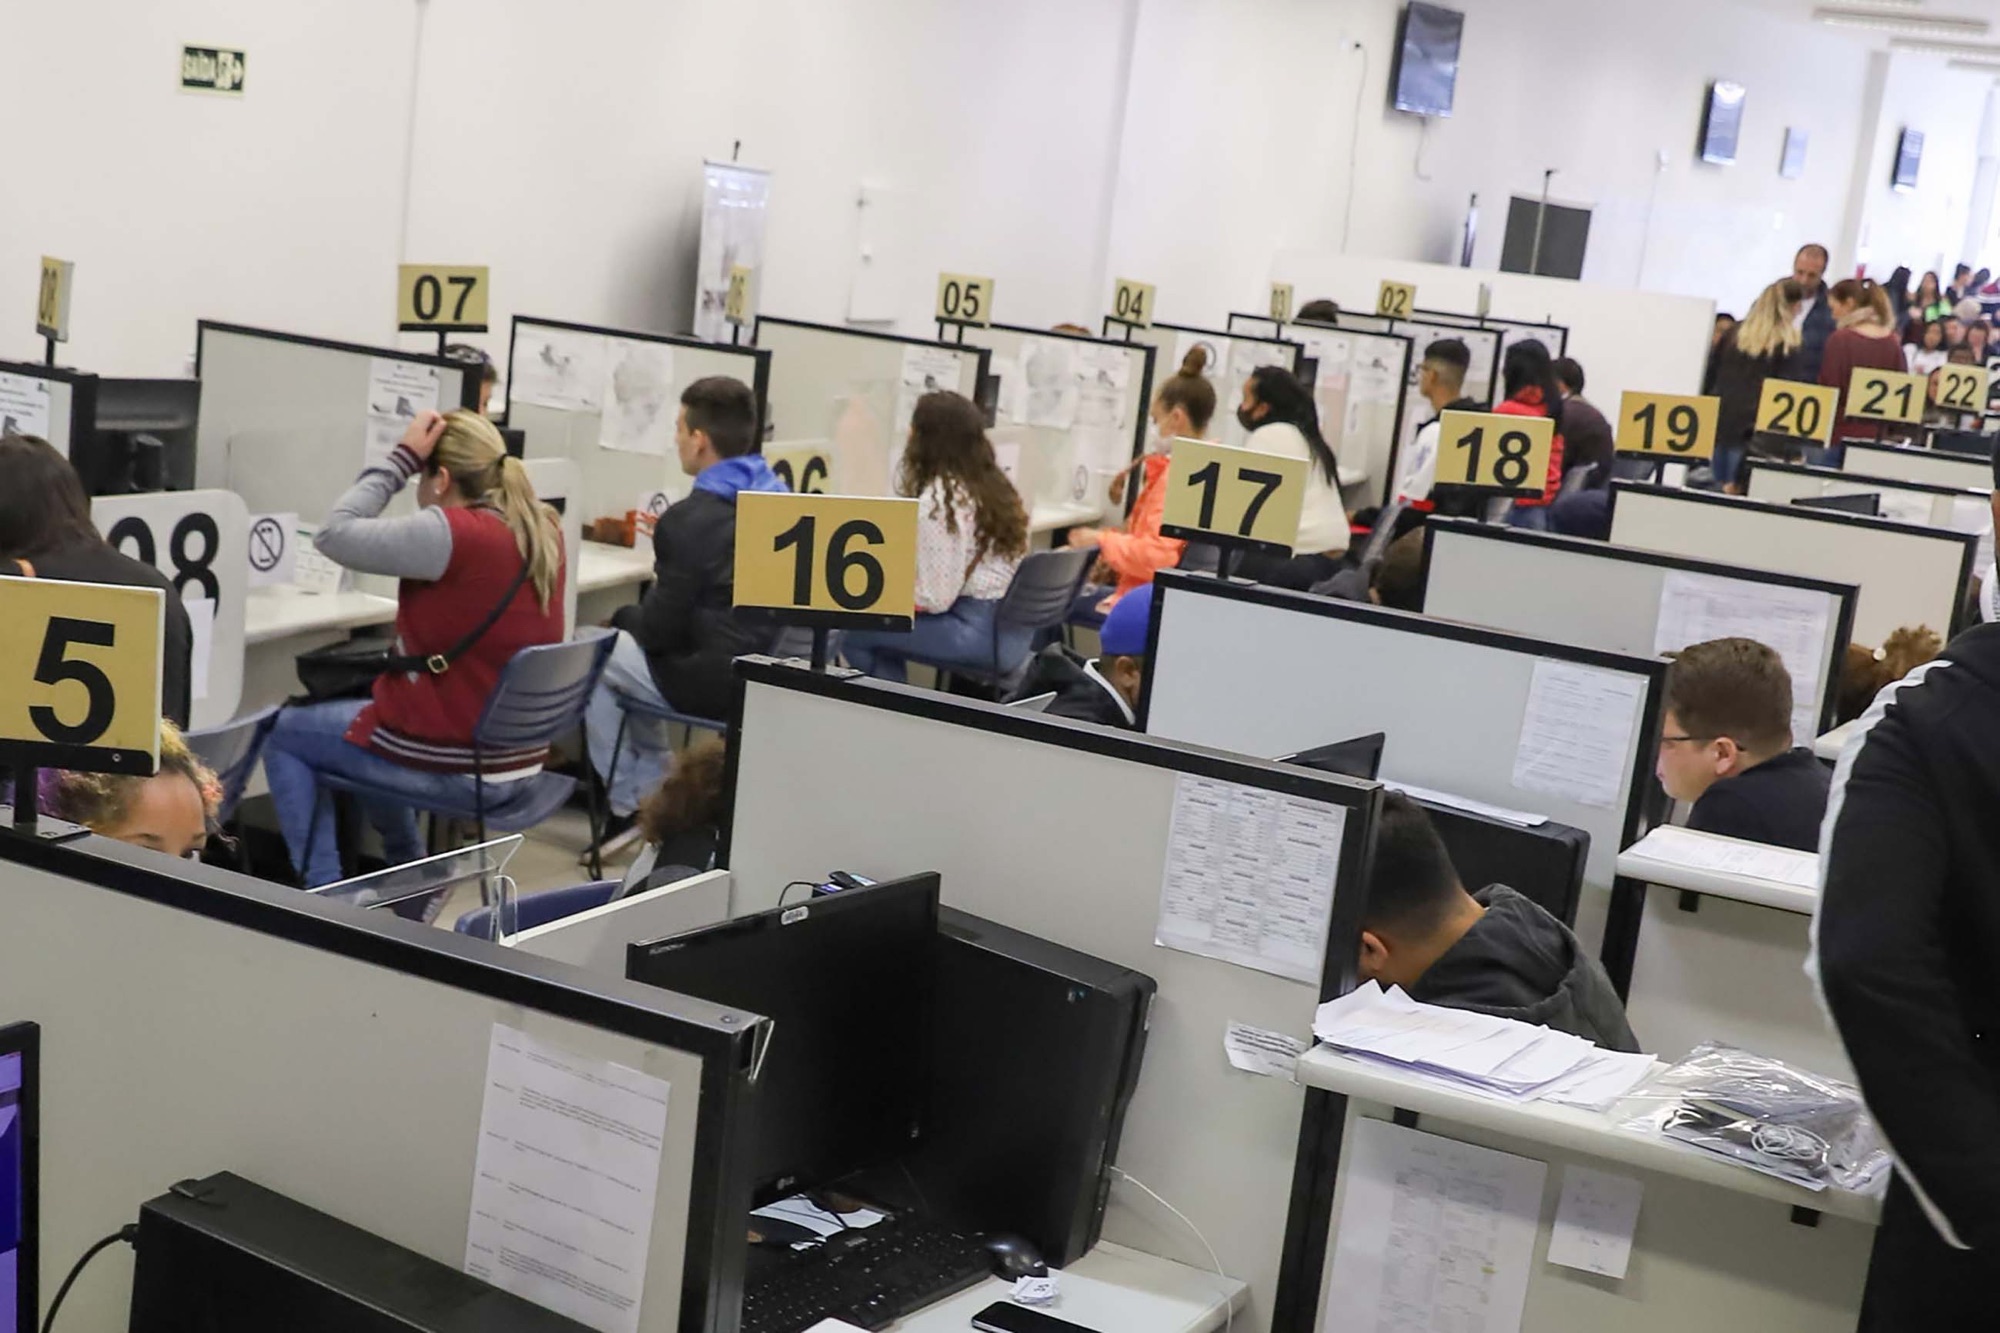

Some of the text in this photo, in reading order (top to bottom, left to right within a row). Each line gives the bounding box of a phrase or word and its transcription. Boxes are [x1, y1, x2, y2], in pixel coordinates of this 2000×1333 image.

[412, 275, 477, 319] 07
[943, 282, 980, 316] 05
[1117, 287, 1144, 318] 04
[1381, 286, 1407, 316] 02
[1860, 379, 1913, 418] 21
[1943, 373, 1977, 407] 22
[1633, 403, 1699, 453] 19
[1767, 391, 1820, 438] 20
[1456, 427, 1531, 487] 18
[1188, 461, 1283, 536] 17
[773, 515, 885, 611] 16
[28, 615, 116, 745] 5
